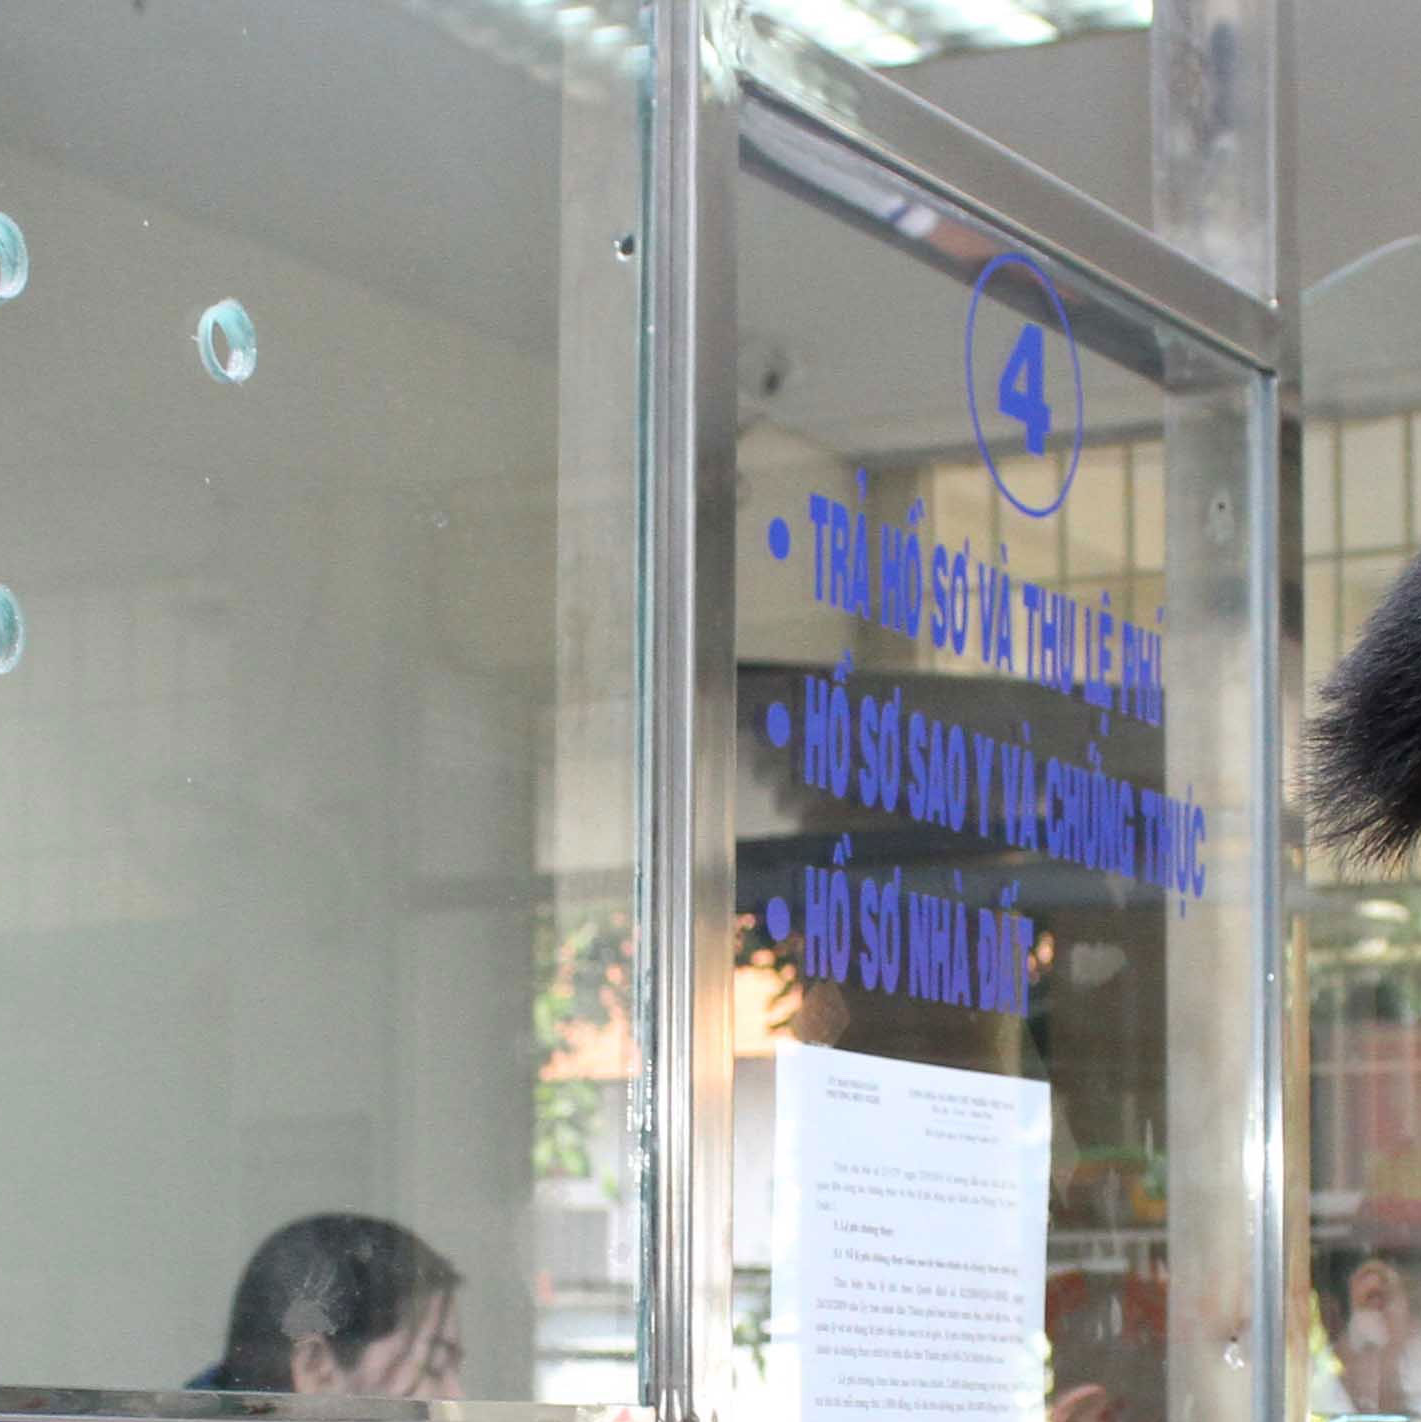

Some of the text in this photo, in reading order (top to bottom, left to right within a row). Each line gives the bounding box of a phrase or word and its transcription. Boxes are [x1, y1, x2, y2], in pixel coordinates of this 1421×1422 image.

[998, 323, 1052, 456] 4
[809, 467, 1165, 737] TRẢ HỒ SƠ VÀ THU LỆ PHÍ
[804, 649, 1205, 920] HỒ SƠ SAO Y VÀ CHỨNG THỰC
[804, 834, 1034, 1018] HỒ SƠ NHÀ ĐẤT
